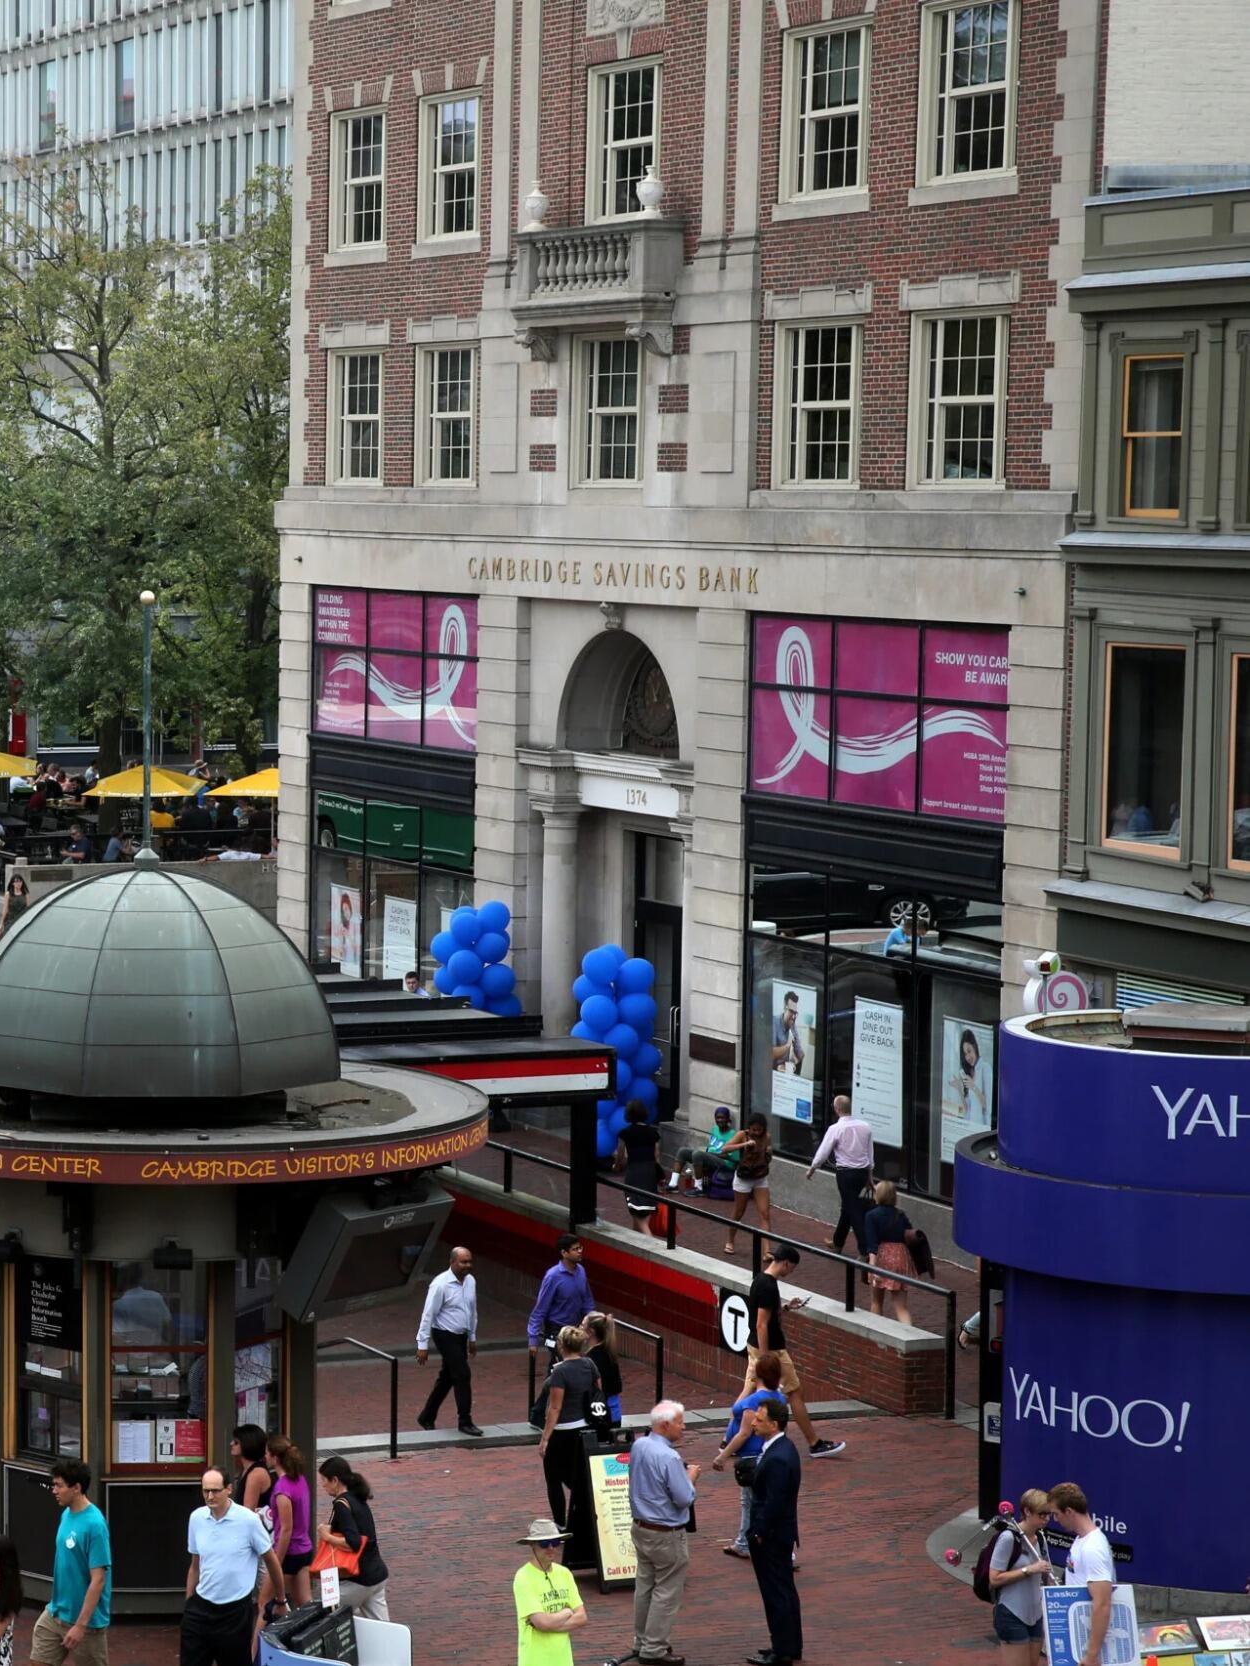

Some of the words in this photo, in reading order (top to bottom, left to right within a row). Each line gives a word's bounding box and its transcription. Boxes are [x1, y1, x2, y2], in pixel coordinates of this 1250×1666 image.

[468, 556, 582, 585] CAMBRIDGE
[594, 562, 685, 590] SAVINGS
[699, 566, 759, 594] BANK
[318, 594, 343, 604] BUILDING
[318, 607, 350, 617] AWARENESS
[318, 619, 338, 629] WITHIN
[338, 620, 350, 630] THE
[935, 652, 965, 665] SHOW
[967, 655, 987, 668] YOU
[989, 656, 1009, 669] CAR
[965, 670, 977, 683] BE
[979, 672, 1008, 686] AWAR
[626, 789, 647, 806] 1374
[864, 1010, 883, 1022] CASH
[862, 1021, 878, 1032] DINE
[860, 1032, 876, 1044] GIVE
[141, 1159, 277, 1181] CAMBRIDGE
[284, 1151, 375, 1176] VISITOR'S
[381, 1132, 468, 1168] INFORMATION
[11, 1154, 102, 1178] CENTER
[31, 1280, 42, 1289] The
[31, 1305, 63, 1317] Information
[727, 1306, 746, 1345] T
[1008, 1366, 1191, 1453] YAHOO!
[605, 1478, 630, 1487] Histori
[1092, 1513, 1127, 1534] bile
[1046, 1536, 1059, 1546] App
[1059, 1538, 1071, 1548] Stor
[1117, 1553, 1132, 1561] play
[607, 1566, 621, 1576] Call
[622, 1565, 637, 1575] 617
[1046, 1590, 1079, 1599] Lasko
[1047, 1601, 1060, 1609] 20
